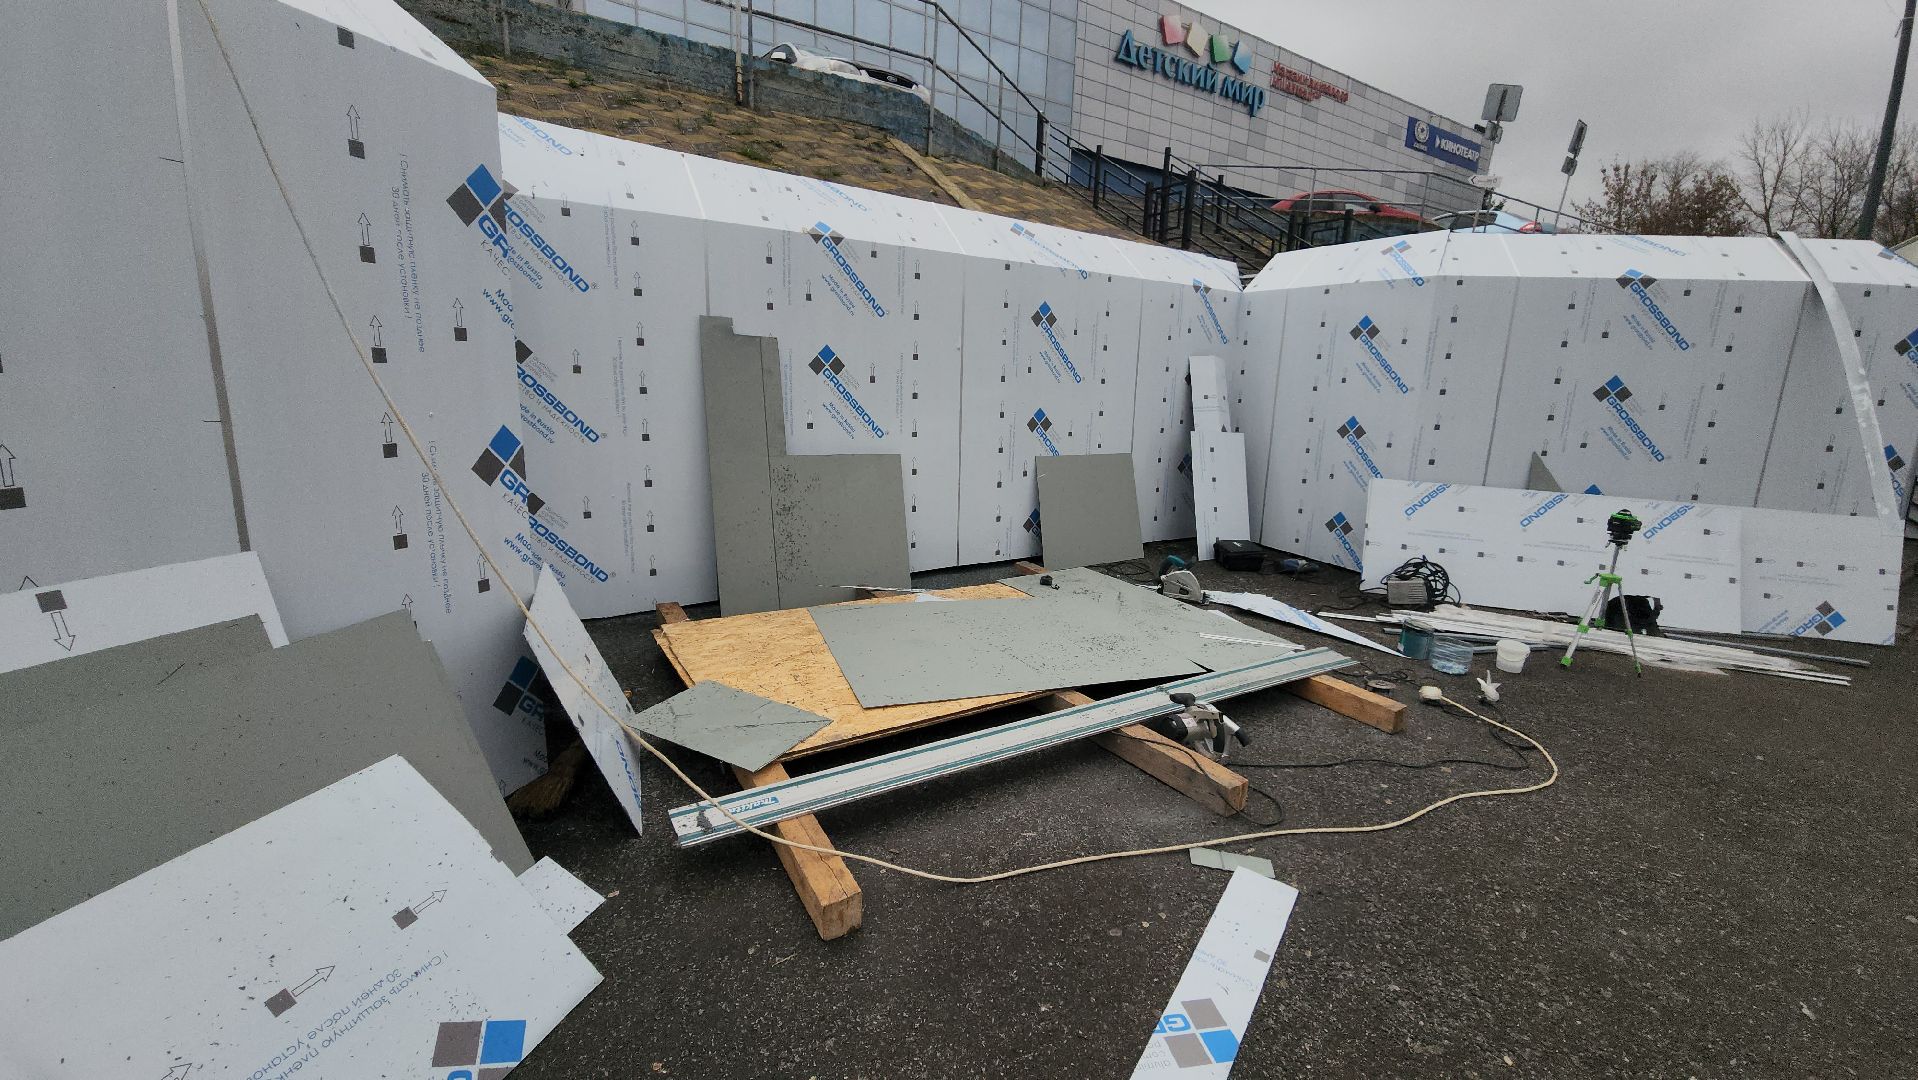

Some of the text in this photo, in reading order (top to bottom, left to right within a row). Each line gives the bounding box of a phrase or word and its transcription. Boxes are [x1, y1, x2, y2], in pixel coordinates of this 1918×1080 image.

[1116, 29, 1219, 94] Детский
[1220, 75, 1266, 117] мир
[1440, 138, 1480, 162] КИНОТЕАТР
[476, 239, 514, 276] КАЧЕС
[523, 260, 543, 281] Russia
[822, 236, 885, 318] GROSSBOND
[1629, 282, 1690, 351] GROSSBOND
[1040, 321, 1082, 384] GROSSBOND
[1360, 334, 1409, 395] GROSSBOND
[516, 364, 600, 444] ROSSBOND
[535, 417, 555, 435] Russia
[822, 367, 885, 439] GROSSBOND
[1606, 396, 1665, 462] GROSSBOND
[499, 493, 530, 519] КАЧЕС
[387, 953, 443, 997] Снимать
[244, 967, 402, 1080] 30 дней после устано
[318, 994, 390, 1049] защитную
[273, 1046, 319, 1080] пленк
